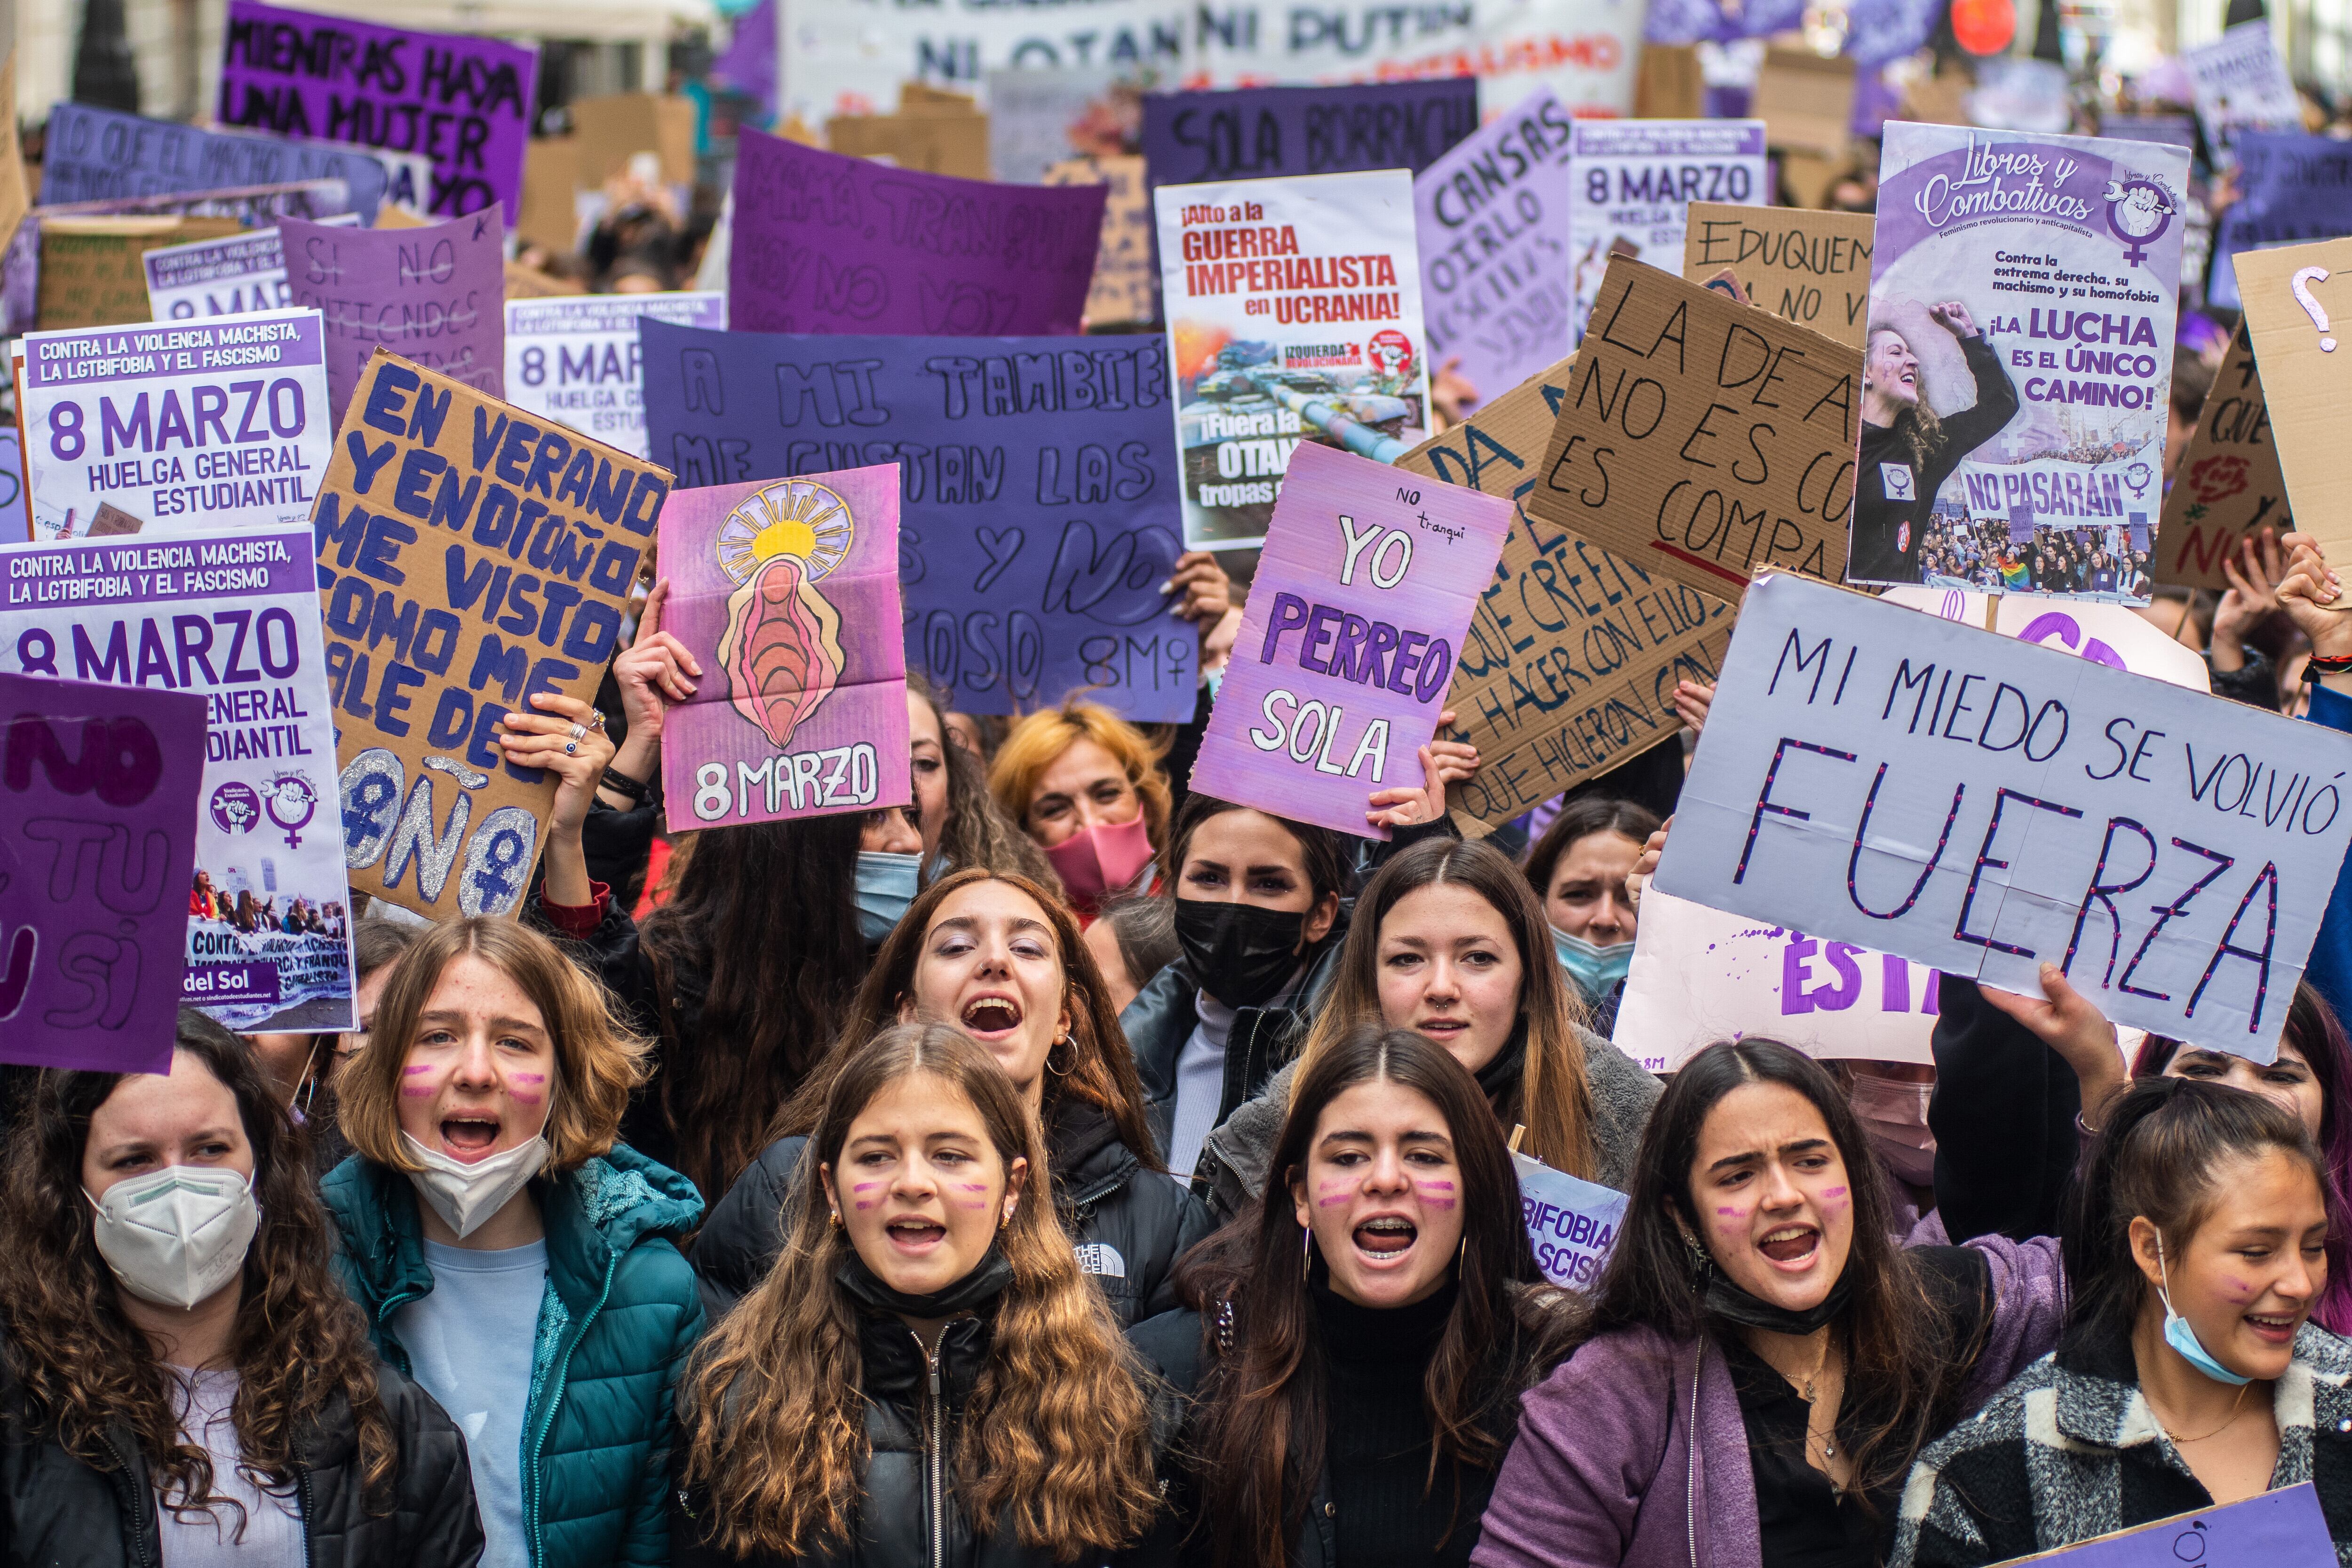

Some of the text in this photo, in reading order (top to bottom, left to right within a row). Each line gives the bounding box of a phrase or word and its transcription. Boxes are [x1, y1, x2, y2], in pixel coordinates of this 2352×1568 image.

[228, 20, 525, 119] MIENTRAS HAYA
[219, 79, 490, 171] UNA MUJER
[1172, 105, 1281, 183] SOLA
[1433, 98, 1571, 229] CANSAS
[1586, 165, 1751, 204] 8 MARZO
[1951, 131, 2079, 190] Libres y
[1181, 201, 1263, 227] ¡Alto a la
[1915, 172, 2094, 227] Combativas
[1183, 225, 1300, 262] GUERRA
[1430, 189, 1542, 294] OIRLO
[1939, 215, 2093, 239] Feminismo revolucionario y anticapitalista
[398, 239, 455, 286] NO
[1185, 255, 1397, 297] IMPERIALISTA
[1994, 268, 2129, 287] extrema derecha, su
[1995, 250, 2058, 267] Contra la
[1245, 292, 1400, 325] en UCRANIA!
[1779, 283, 1821, 321] NO
[1993, 279, 2160, 303] machismo y su homofobia
[40, 323, 302, 361] CONTRA LA VIOLENCIA MACHISTA,
[1285, 344, 1346, 358] IZQUIERDA
[1601, 280, 1687, 375] LA
[1718, 323, 1806, 409] DE
[1989, 308, 2157, 348] ¡LA LUCHA
[40, 345, 281, 382] LA LGTBIFOBIA Y EL FASCISMO
[520, 346, 545, 387] 8
[2011, 342, 2156, 378] ES EL ÚNICO
[546, 390, 617, 410] HUELGA
[681, 348, 723, 415] A
[775, 359, 890, 427] MI
[2025, 378, 2153, 410] CAMINO!
[48, 377, 306, 462] 8 MARZO
[1201, 410, 1301, 437] ¡Fuera la
[1576, 356, 1666, 439] NO
[1679, 403, 1777, 486] ES
[87, 445, 310, 493] HUELGA GENERAL
[363, 361, 670, 537] EN VERANO
[1036, 441, 1155, 506] LAS
[153, 476, 313, 517] ESTUDIANTIL
[346, 430, 642, 598] Y EN OTOÑO
[1199, 482, 1272, 507] tropas
[1395, 487, 1420, 505] NO
[1548, 435, 1850, 584] ES COMPA
[1966, 465, 2124, 517] NO PASARÁN
[1339, 514, 1414, 589] YO
[1417, 511, 1465, 546] tranqui
[10, 540, 291, 578] CONTRA LA VIOLENCIA MACHISTA,
[316, 492, 622, 664] ME VISTO
[974, 526, 1025, 593] Y
[1041, 519, 1187, 627] NO
[9, 567, 269, 604] LA LGTBIFOBIA Y EL FASCISMO
[72, 607, 300, 690] MARZO
[1260, 591, 1453, 704] PERREO
[1476, 606, 1644, 740] HACER CON
[469, 634, 582, 717] ME
[1249, 689, 1391, 783] SOLA
[1459, 752, 1540, 821] QUE
[1540, 679, 1659, 783] HICIERON
[1768, 628, 2346, 836] MI MIEDO SE VOLVIÓ
[3, 712, 163, 808] NO
[693, 741, 879, 821] 8 MARZO
[24, 816, 170, 915] TU
[1733, 736, 2280, 1035] FUERZA
[183, 969, 249, 992] del Sol
[207, 992, 271, 1001] sindicatodeestudiantes.net
